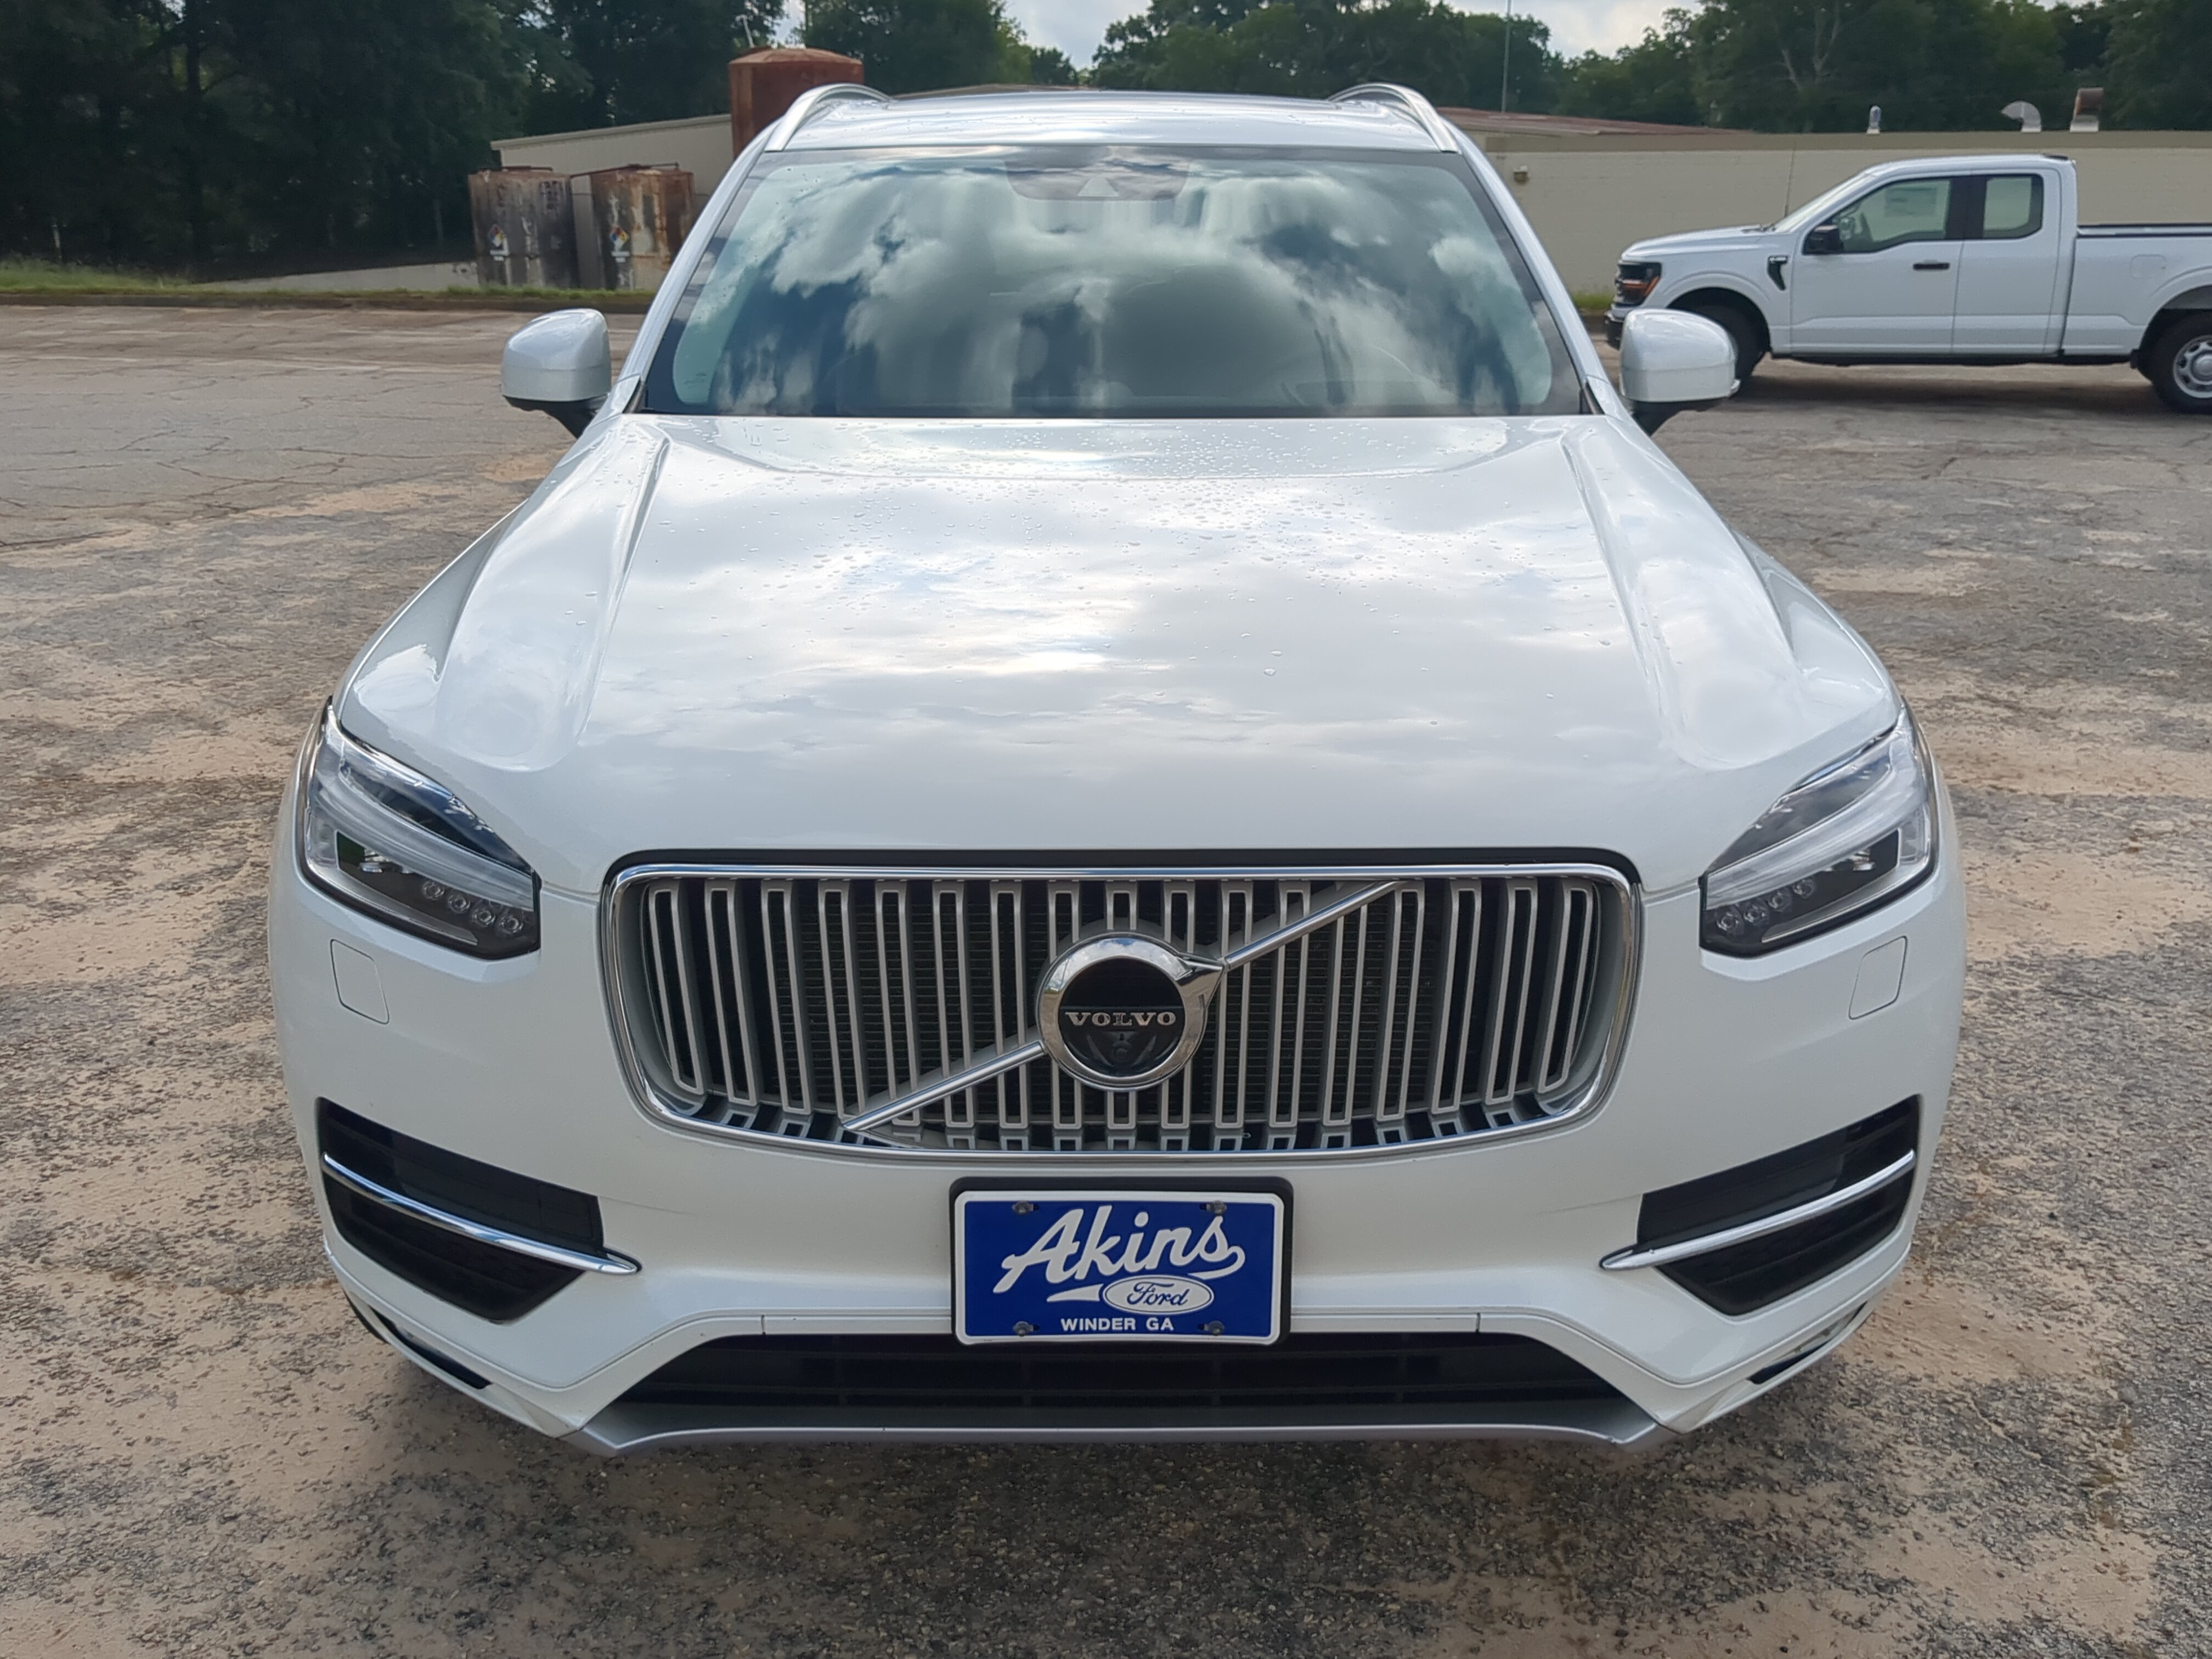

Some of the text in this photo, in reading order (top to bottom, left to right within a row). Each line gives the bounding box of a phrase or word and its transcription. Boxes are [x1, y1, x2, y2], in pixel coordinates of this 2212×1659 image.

[1065, 1012, 1176, 1026] VOLVO
[993, 1205, 1245, 1294] Akins
[1126, 1283, 1189, 1306] Ford
[1060, 1318, 1174, 1331] WINDER GA
